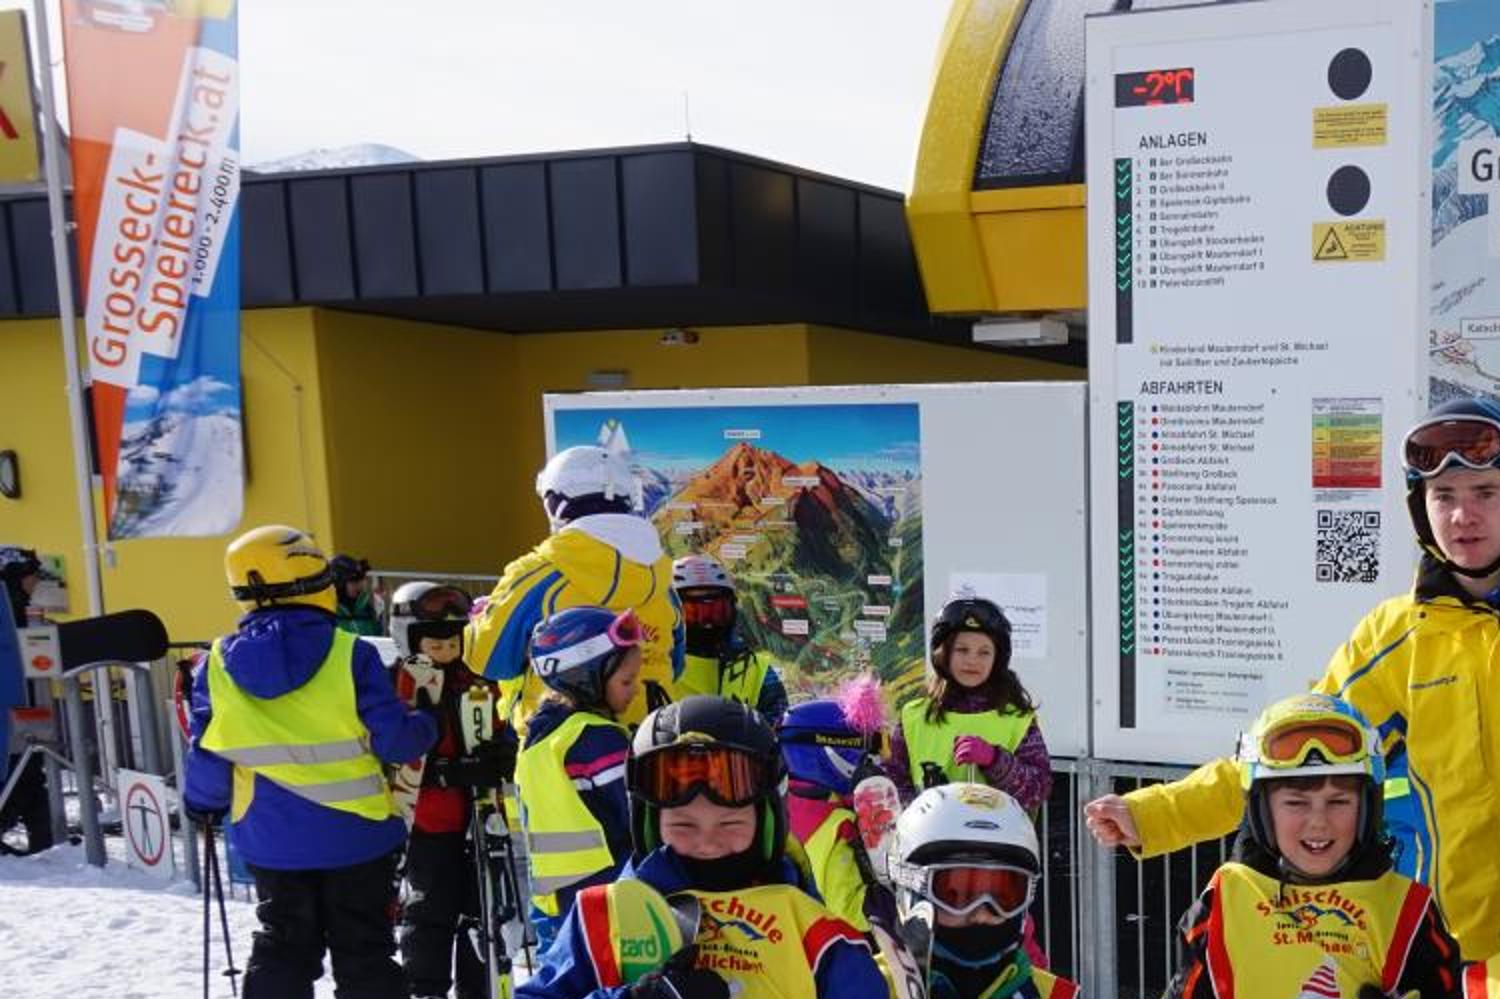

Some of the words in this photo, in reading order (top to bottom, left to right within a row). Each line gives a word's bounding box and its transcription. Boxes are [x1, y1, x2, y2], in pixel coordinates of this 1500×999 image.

[1138, 131, 1207, 149] ANLAGEN
[136, 63, 231, 340] Speiereck.at
[92, 153, 164, 367] Grosseck-
[1140, 381, 1224, 395] ABFAHRTEN
